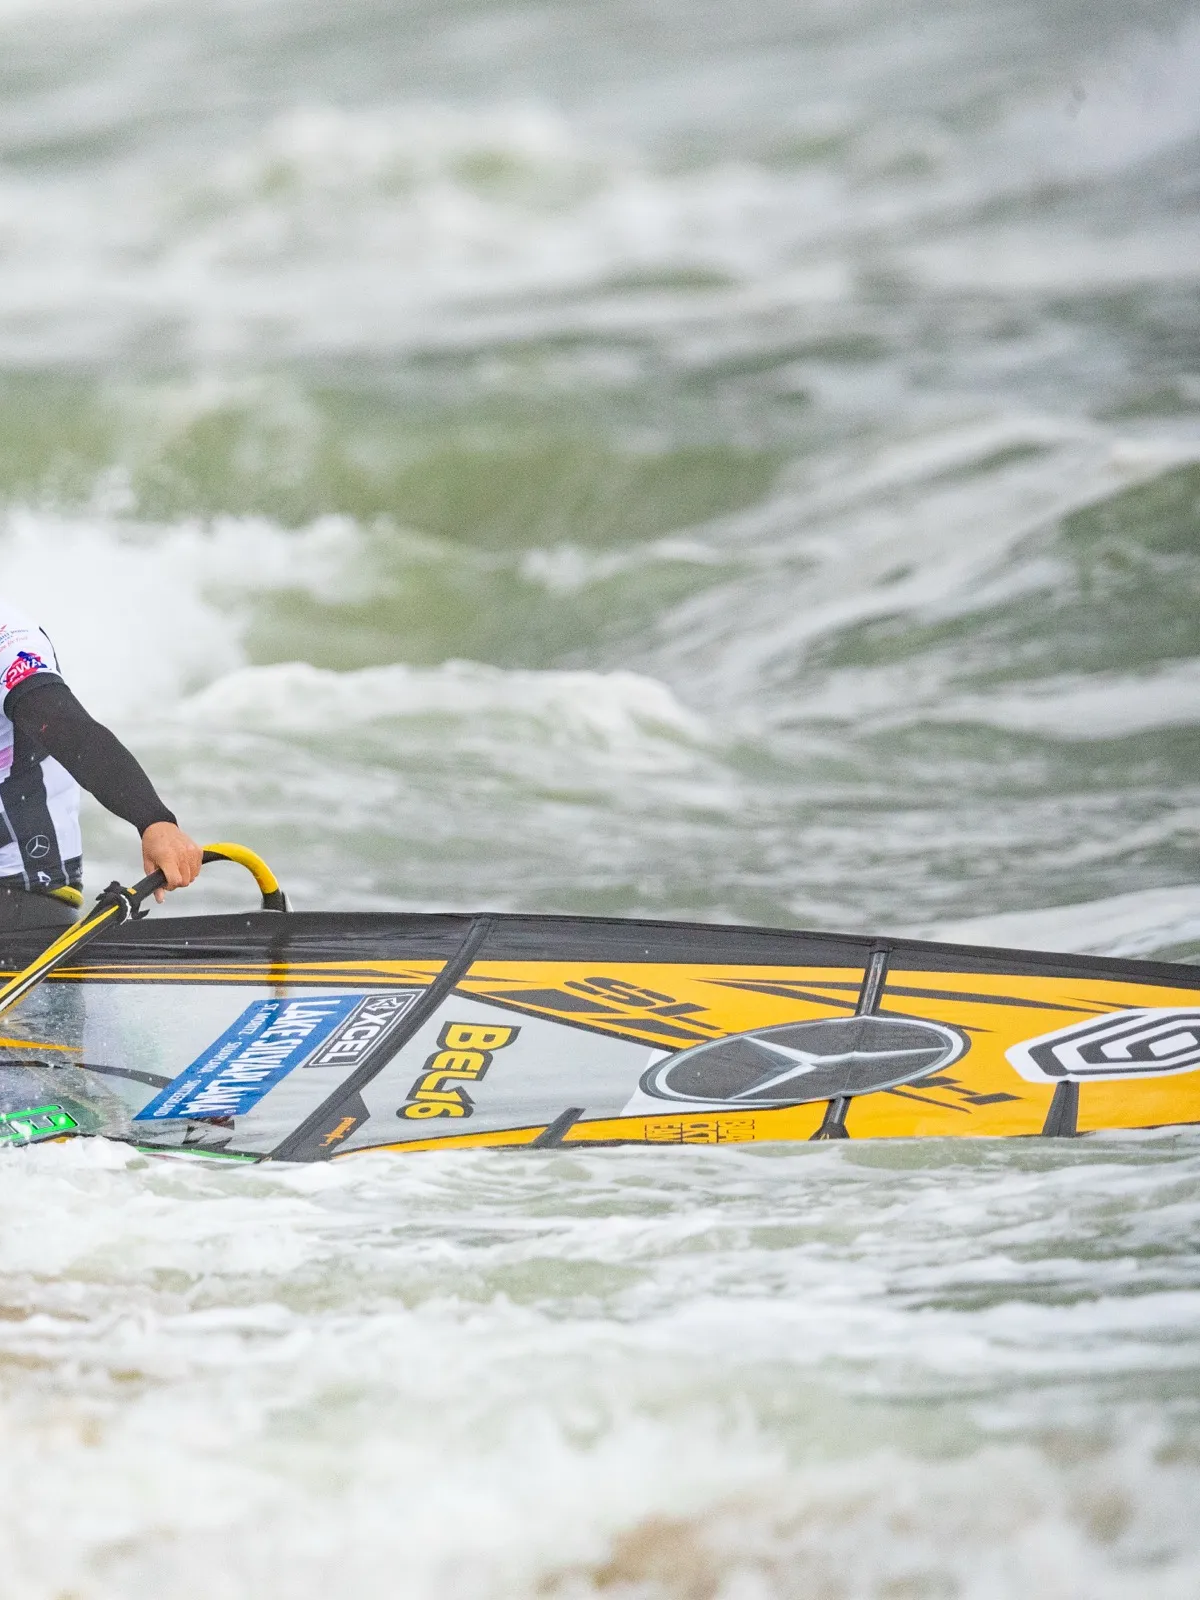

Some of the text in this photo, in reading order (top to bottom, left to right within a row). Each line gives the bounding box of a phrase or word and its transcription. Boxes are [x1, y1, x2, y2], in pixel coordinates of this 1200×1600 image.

[265, 1000, 342, 1038] LAKE
[318, 1005, 391, 1063] XCEL
[180, 1033, 303, 1115] SILVAPLANA
